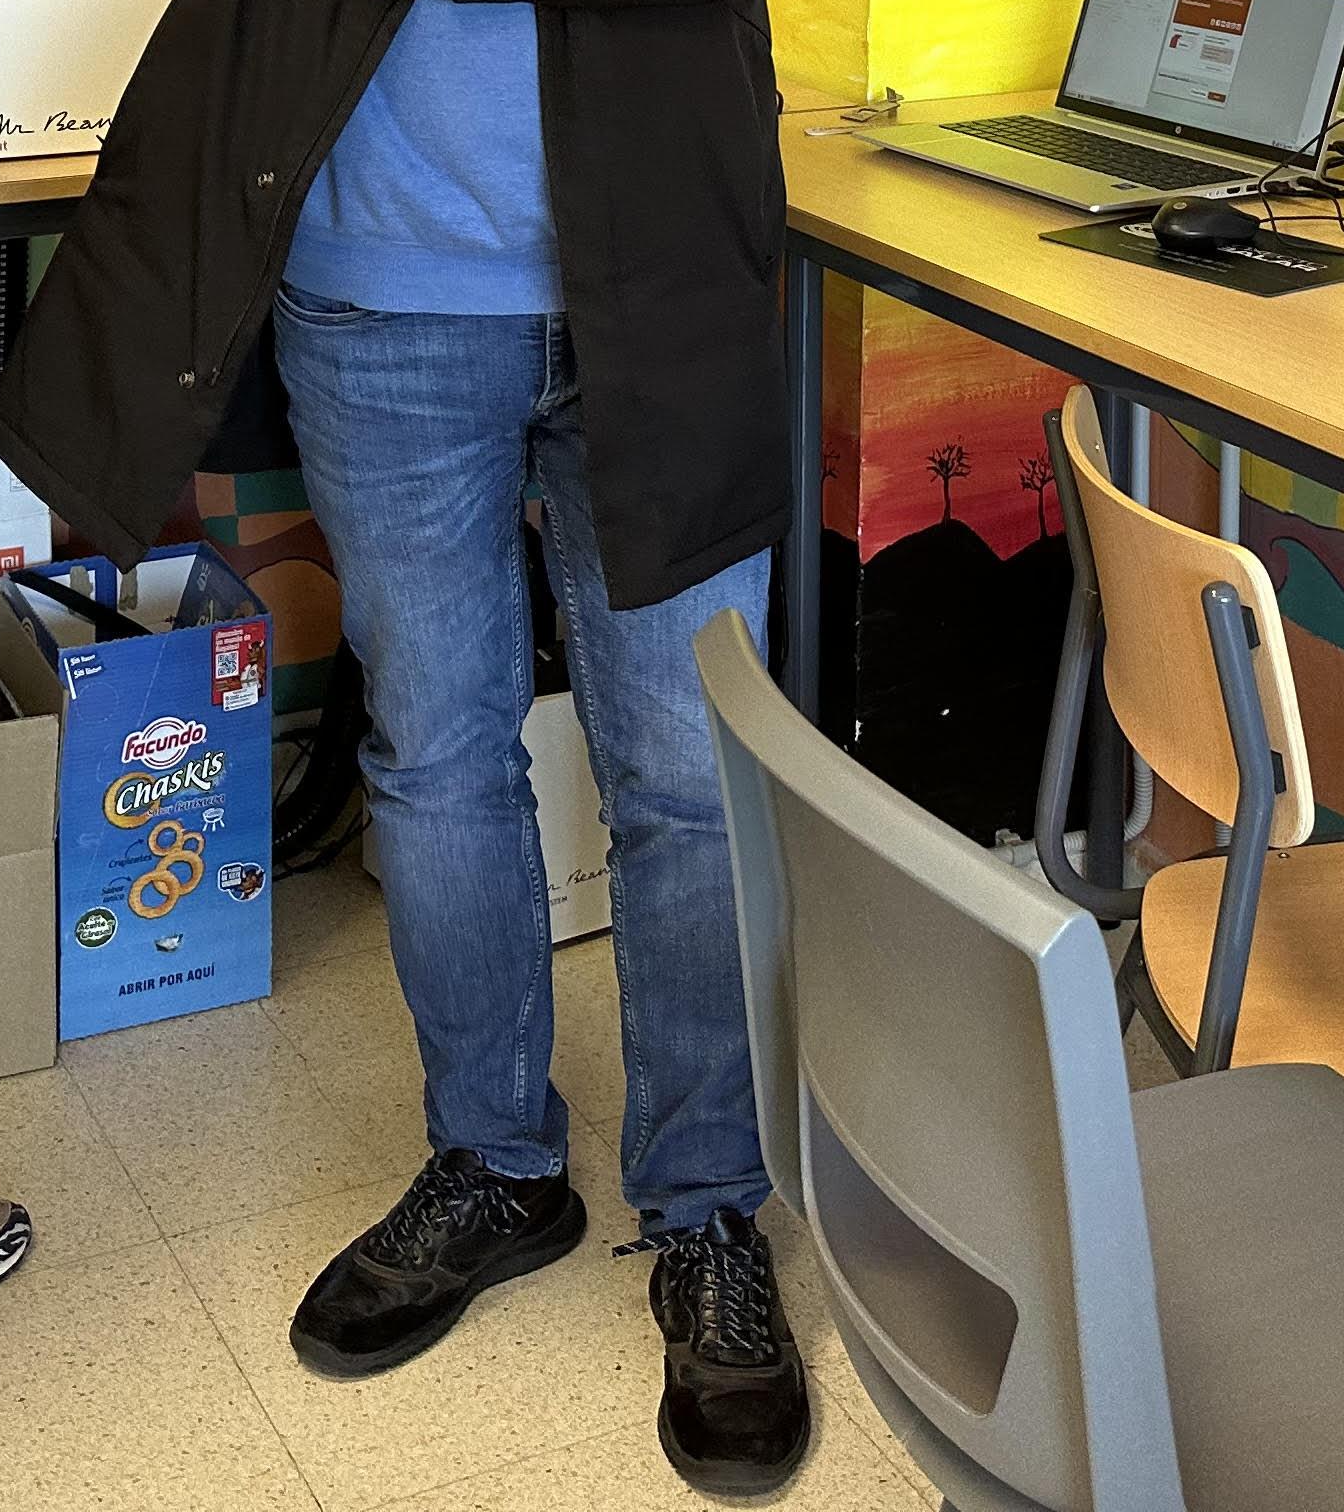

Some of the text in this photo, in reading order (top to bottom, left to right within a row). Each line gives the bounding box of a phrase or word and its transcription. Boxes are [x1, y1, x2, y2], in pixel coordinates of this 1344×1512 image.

[124, 724, 204, 761] Facundo
[116, 751, 225, 816] Chaskis
[119, 962, 216, 997] ABRIR POR AQUÍ
